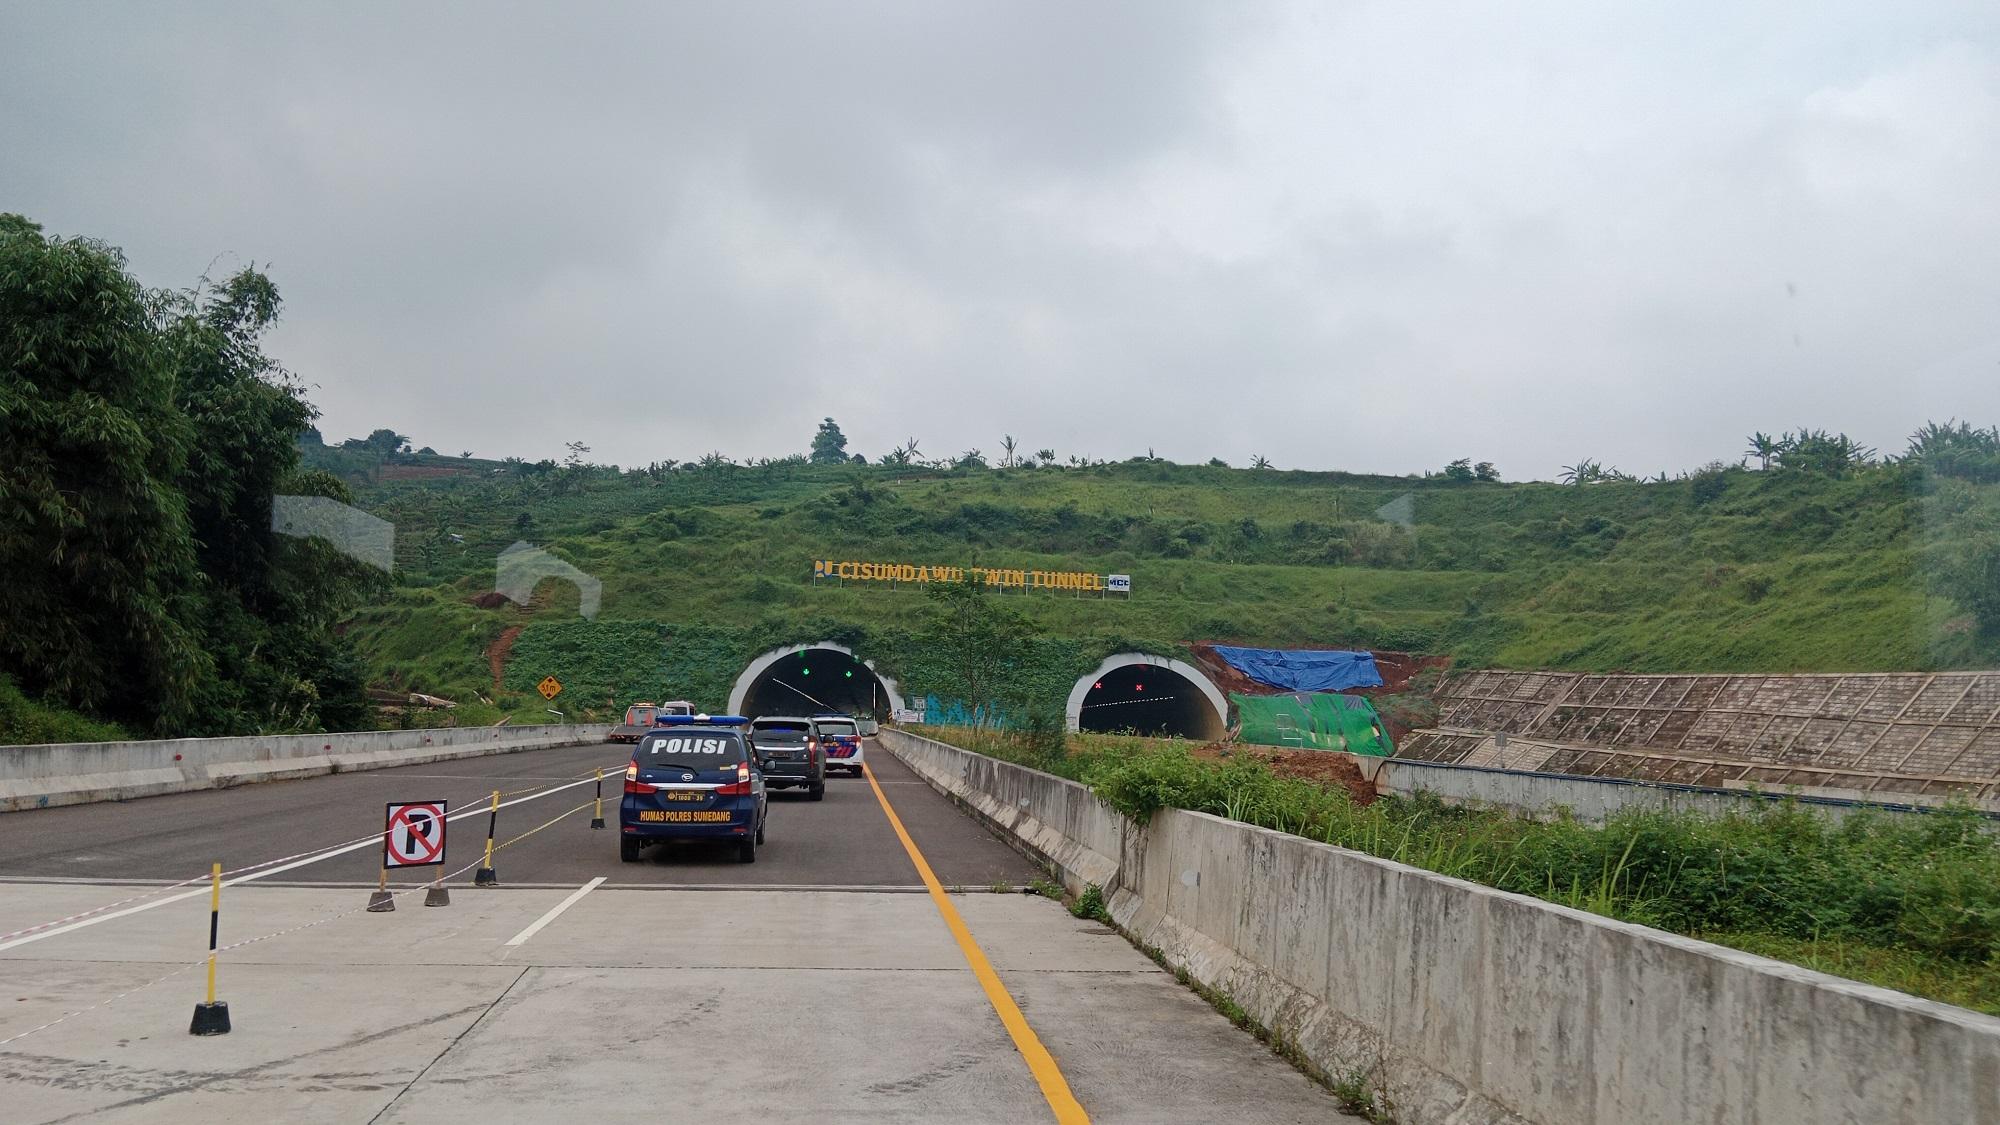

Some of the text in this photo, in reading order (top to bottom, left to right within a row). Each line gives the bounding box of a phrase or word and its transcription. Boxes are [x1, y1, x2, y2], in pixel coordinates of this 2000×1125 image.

[970, 567, 1025, 587] TWIN
[1031, 570, 1104, 591] TUNNEL
[651, 738, 727, 754] POLISI
[640, 811, 731, 822] HUMAS POLRES SUMEDANG
[405, 814, 432, 854] P
